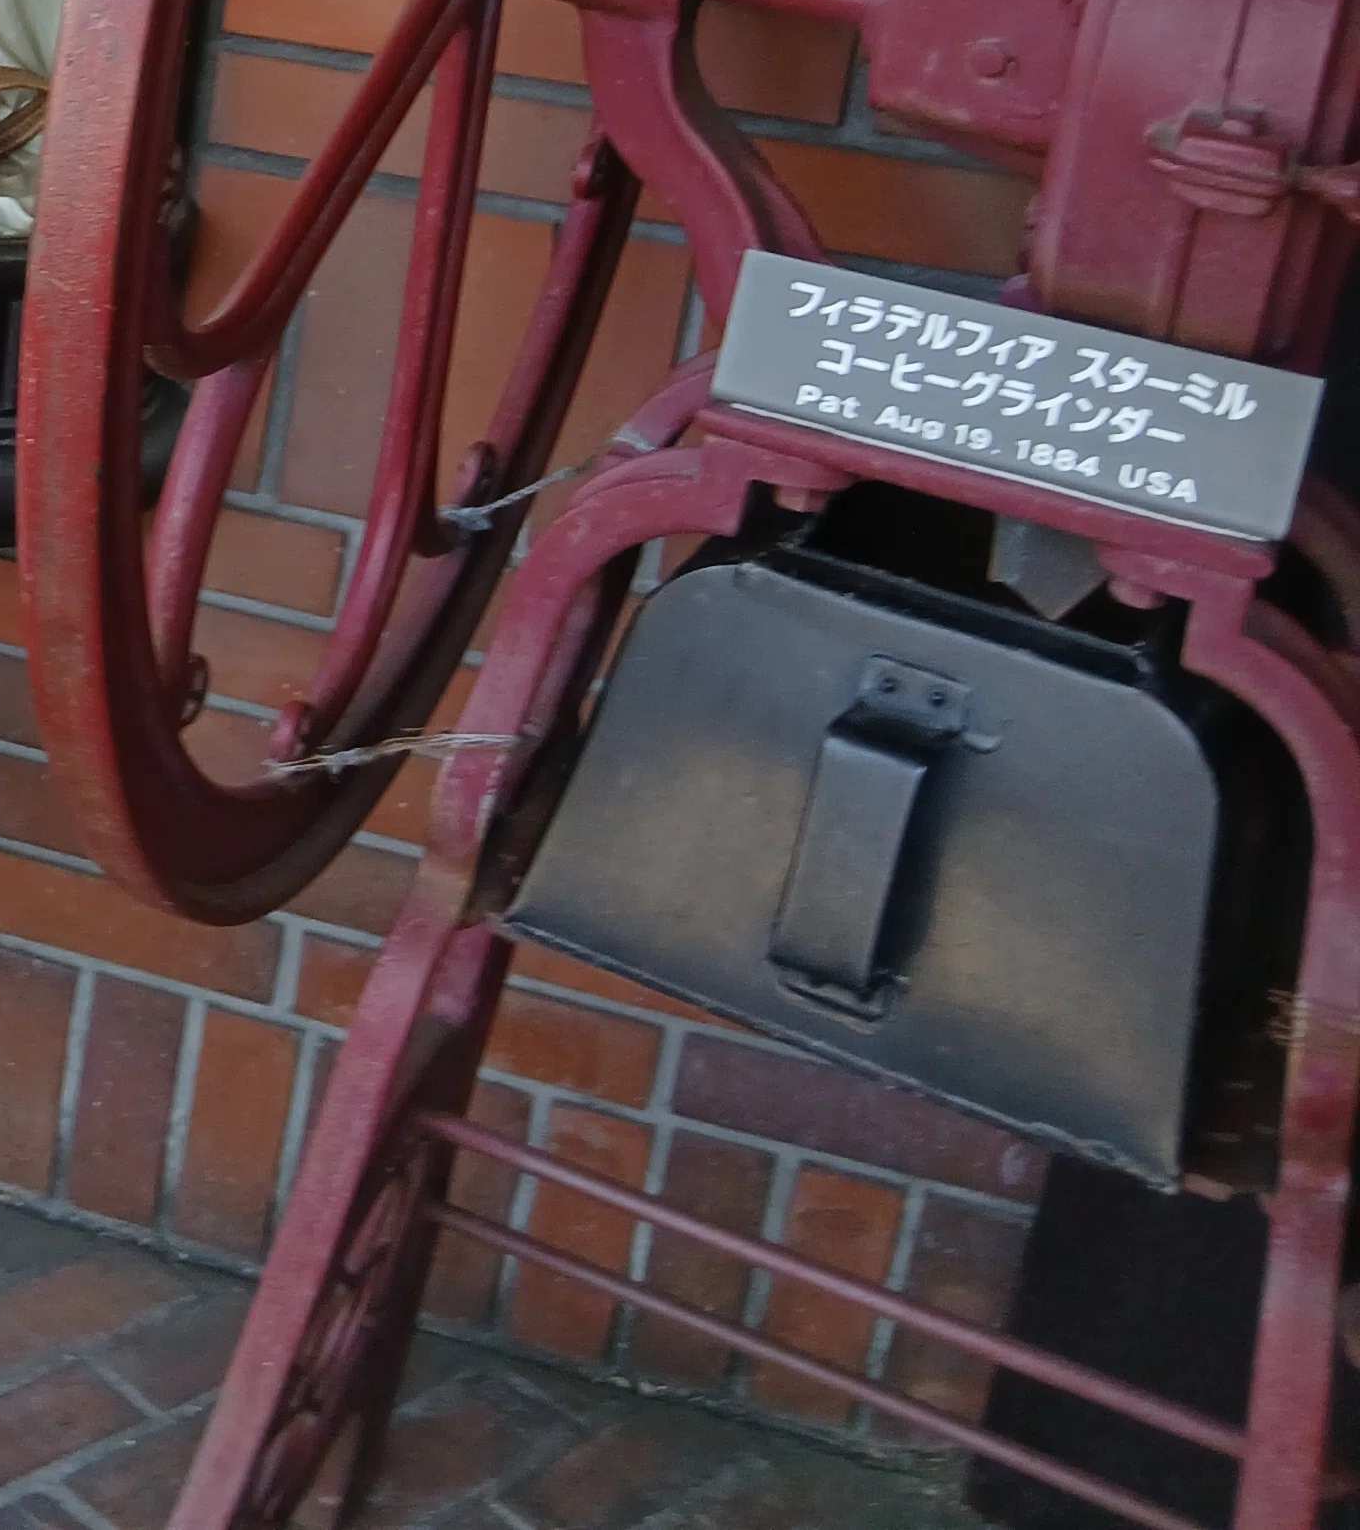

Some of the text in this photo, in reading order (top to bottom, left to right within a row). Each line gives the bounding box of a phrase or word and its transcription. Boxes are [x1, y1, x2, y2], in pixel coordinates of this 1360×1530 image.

[787, 280, 1258, 421] フィラデルフィア スターミル
[815, 339, 1186, 447] コーヒーグラインダー
[795, 384, 862, 419] Pat
[874, 404, 946, 441] Aug
[1015, 439, 1101, 478] 1884
[1117, 463, 1198, 503] USA
